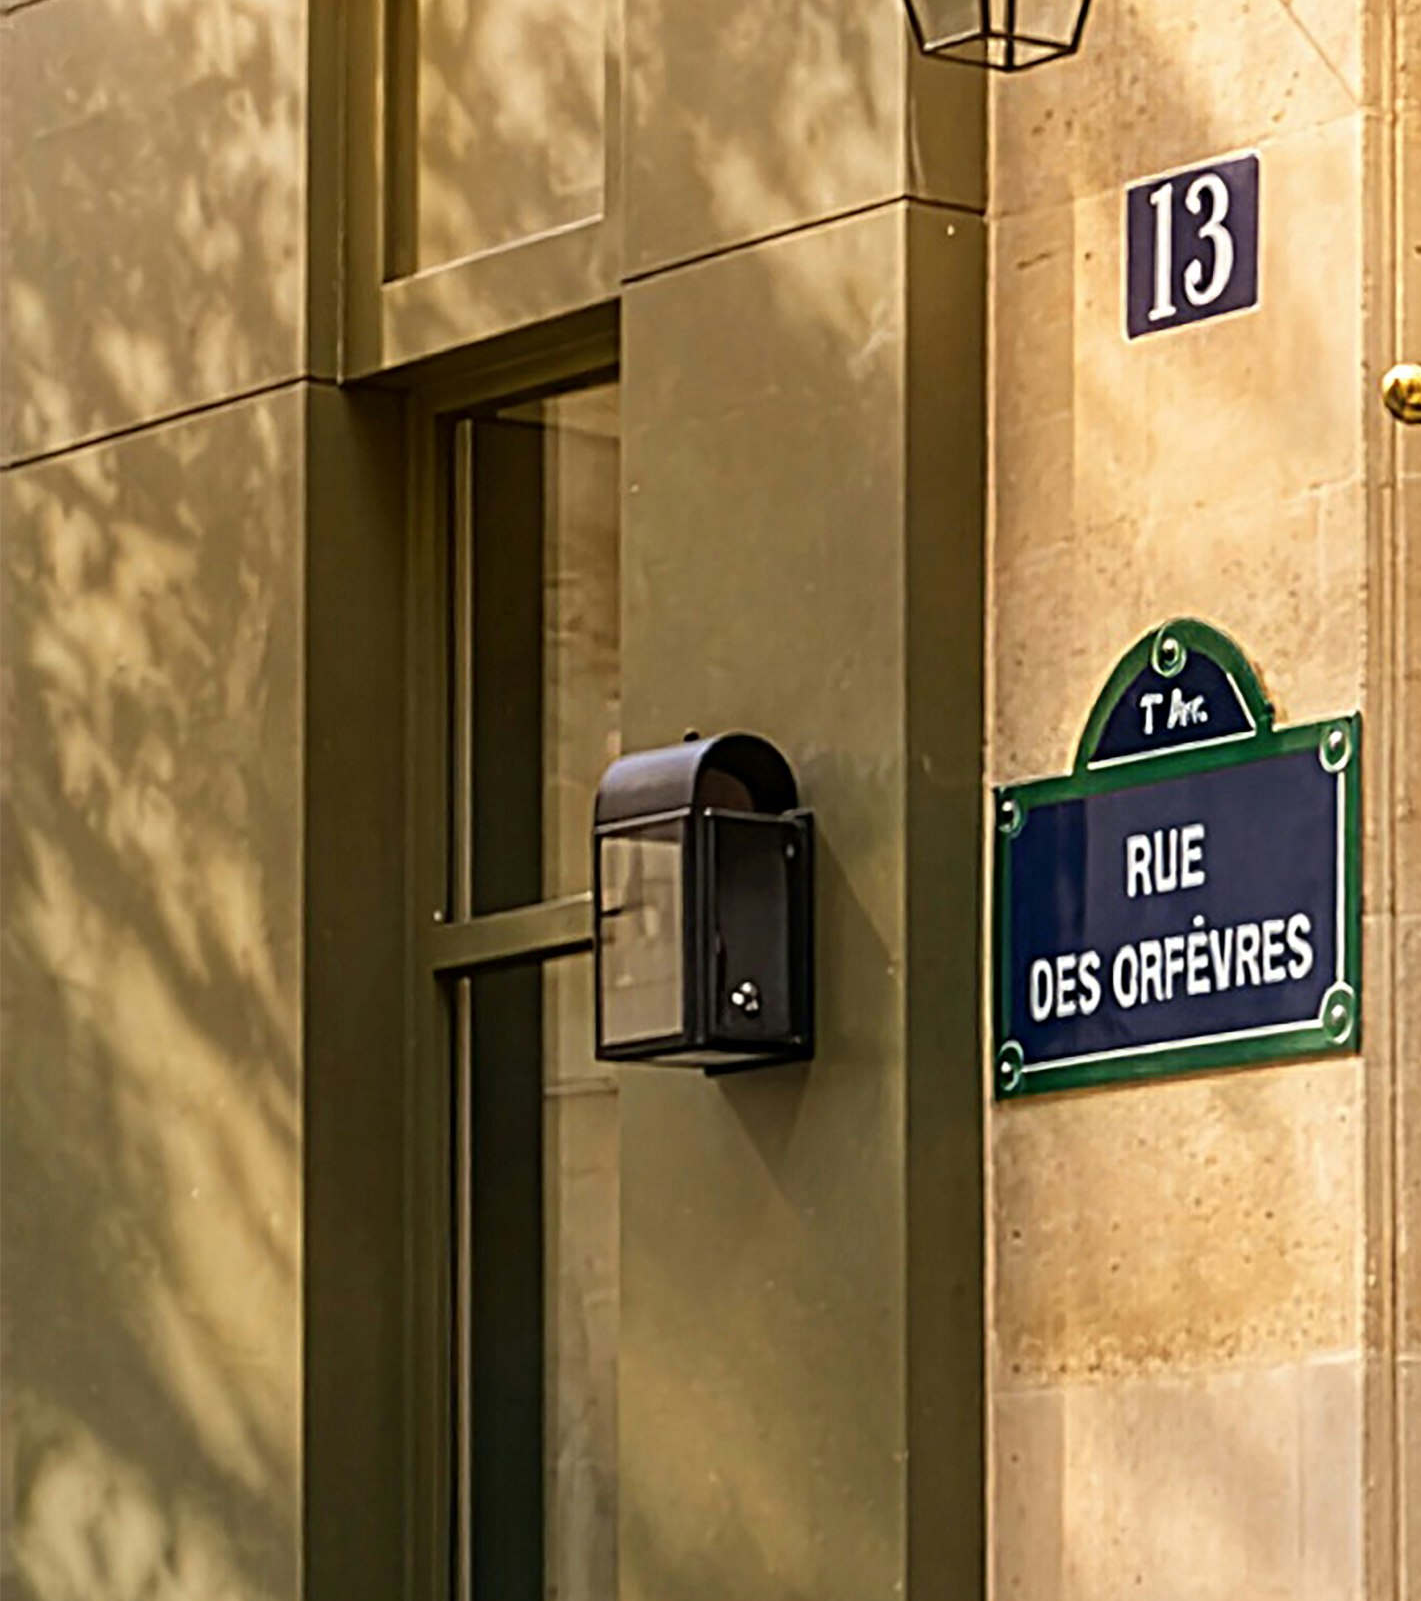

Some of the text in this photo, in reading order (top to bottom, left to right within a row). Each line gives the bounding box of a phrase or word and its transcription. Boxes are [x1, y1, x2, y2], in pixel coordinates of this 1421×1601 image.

[1147, 172, 1235, 322] 13
[1126, 823, 1206, 898] RUE
[1030, 950, 1101, 1022] DES
